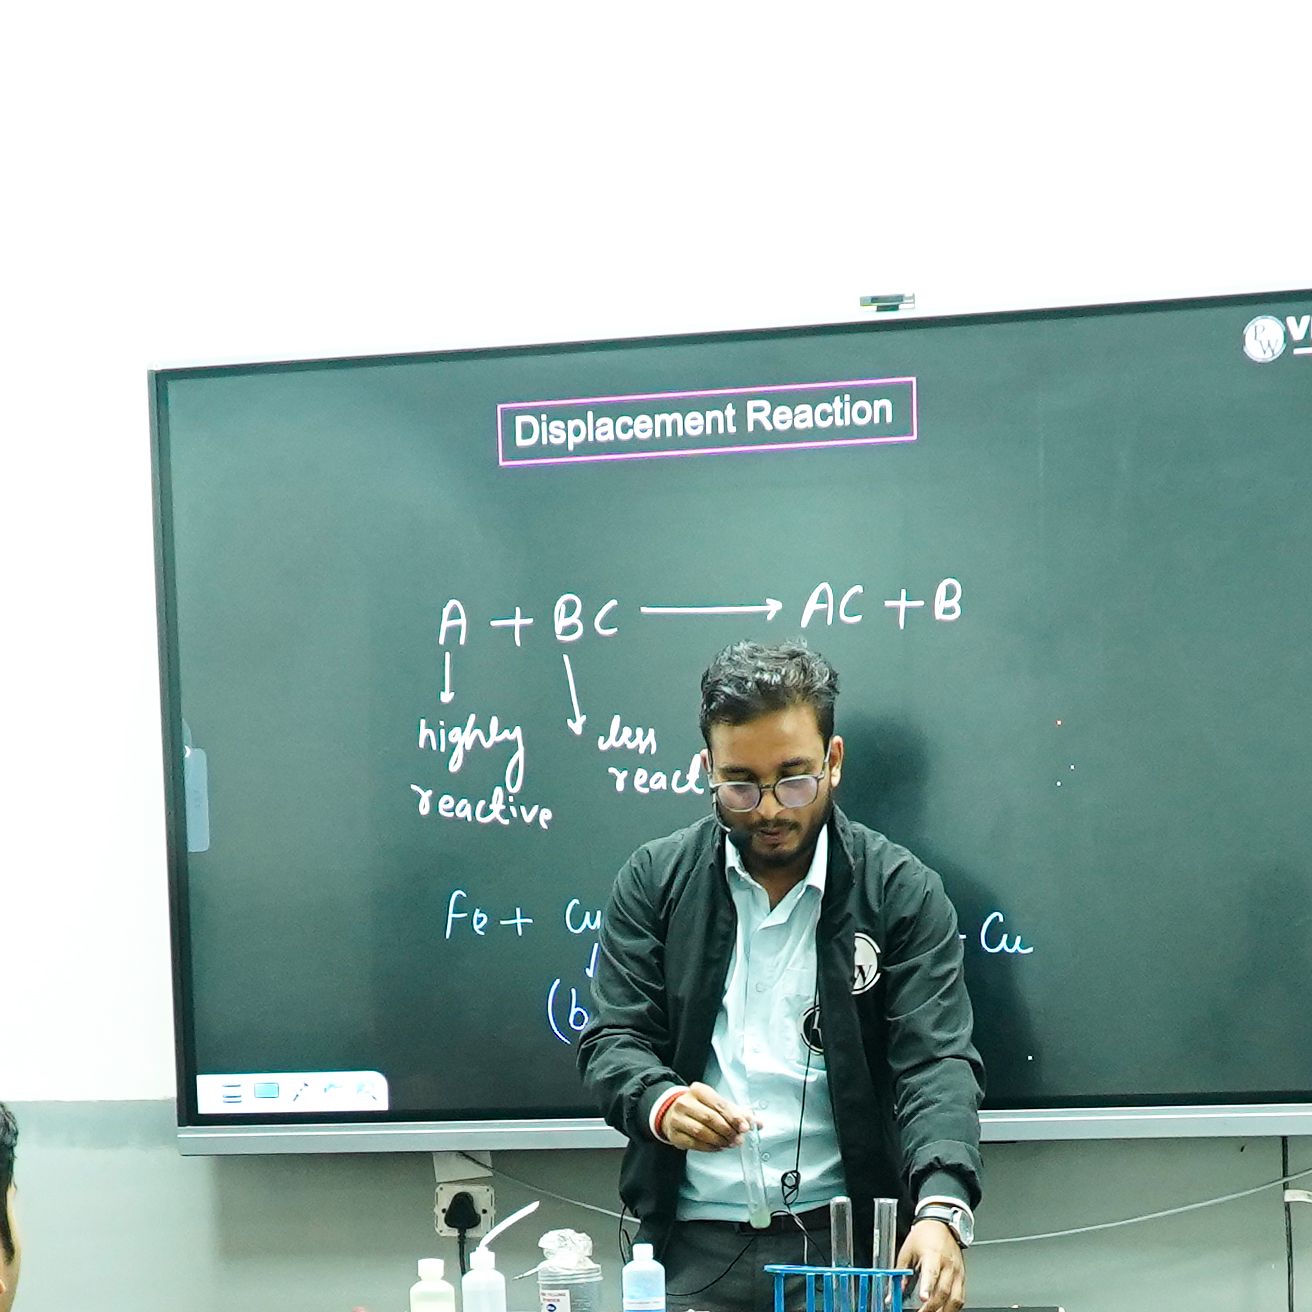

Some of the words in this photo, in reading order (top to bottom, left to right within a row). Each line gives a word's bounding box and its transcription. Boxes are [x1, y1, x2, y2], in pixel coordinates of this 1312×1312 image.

[514, 403, 736, 452] Displacement
[746, 393, 893, 433] Reaction
[438, 598, 467, 646] A
[800, 581, 864, 629] AC
[933, 577, 963, 621] B
[418, 713, 525, 794] highly
[597, 714, 657, 755] less
[410, 786, 553, 830] reactive
[608, 752, 706, 795] react
[445, 889, 489, 940] Fe
[565, 898, 603, 934] Cu
[979, 911, 1034, 954] Cu
[546, 977, 591, 1045] (b
